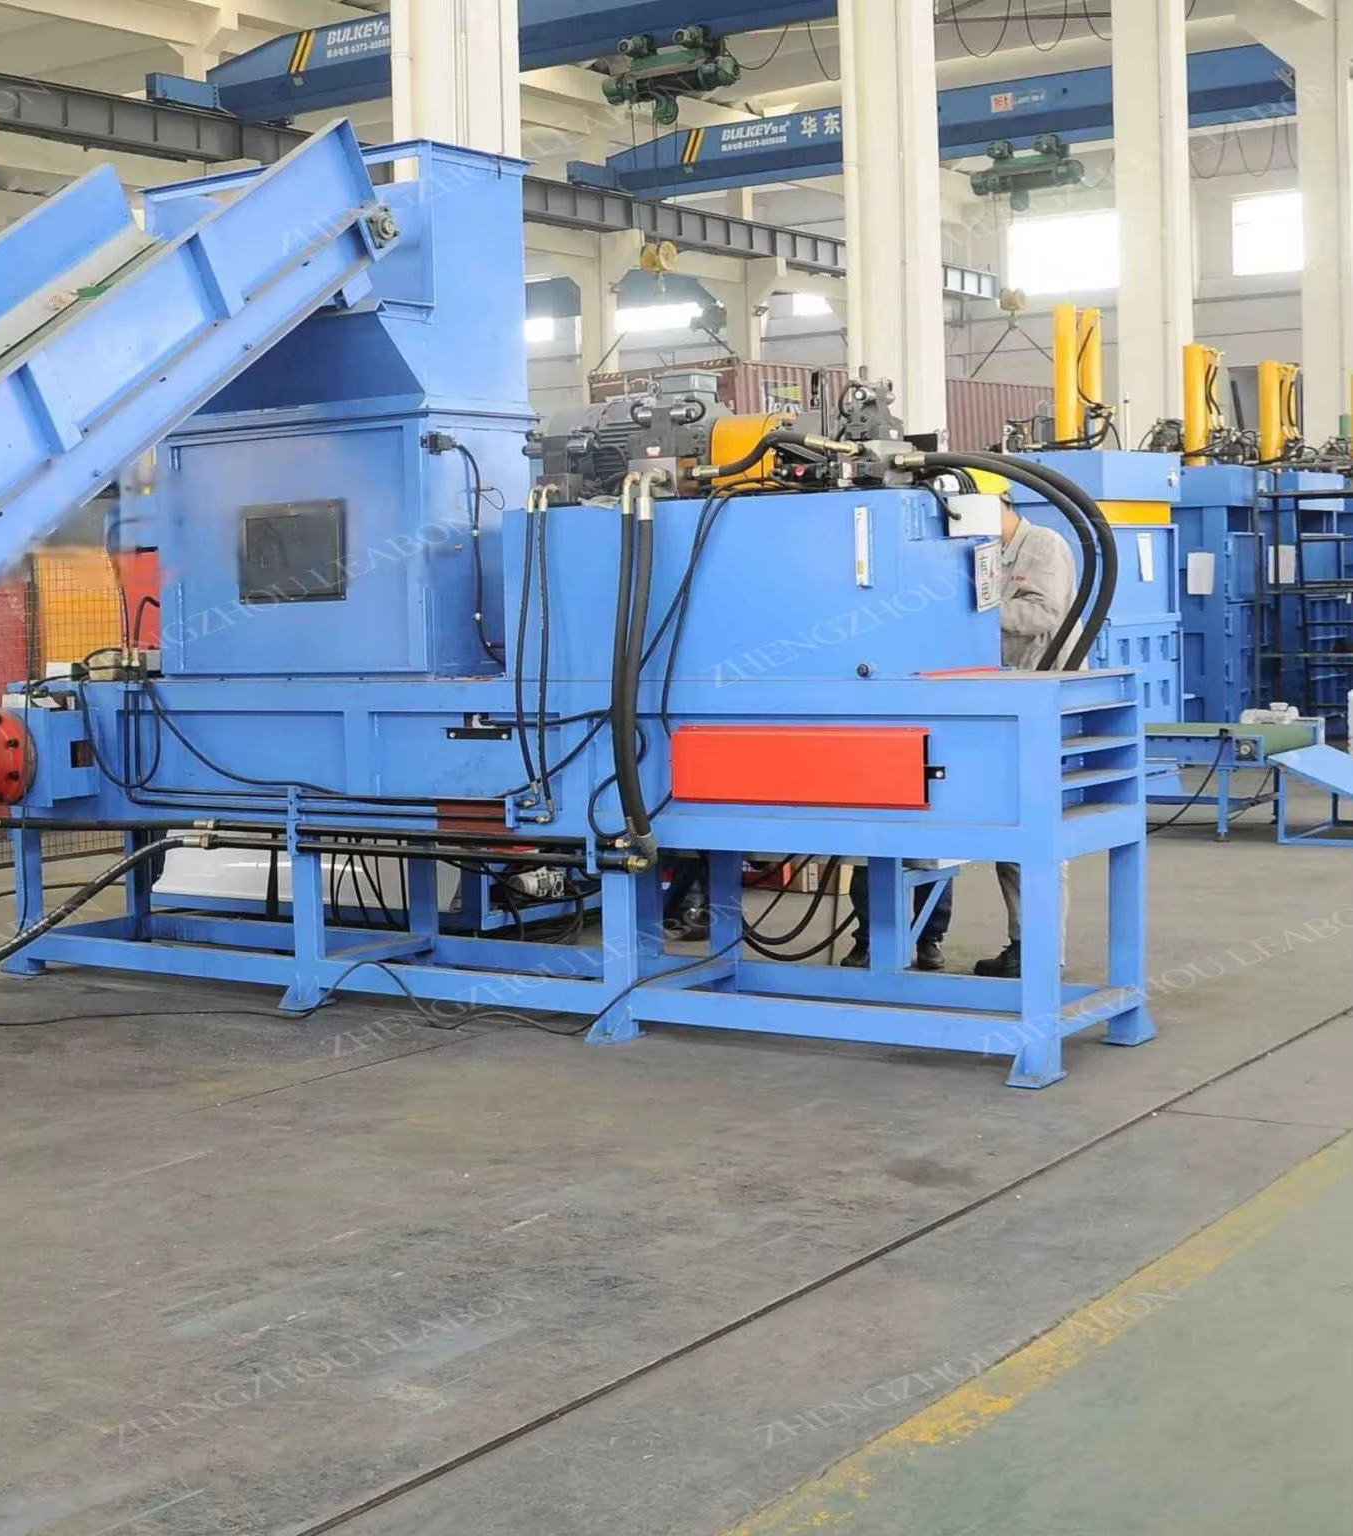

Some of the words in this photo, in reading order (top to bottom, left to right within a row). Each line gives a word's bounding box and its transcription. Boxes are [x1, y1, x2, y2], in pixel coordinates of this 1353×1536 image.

[326, 20, 383, 46] BULKEY
[720, 122, 773, 142] BULKEY
[800, 112, 841, 138] 华东
